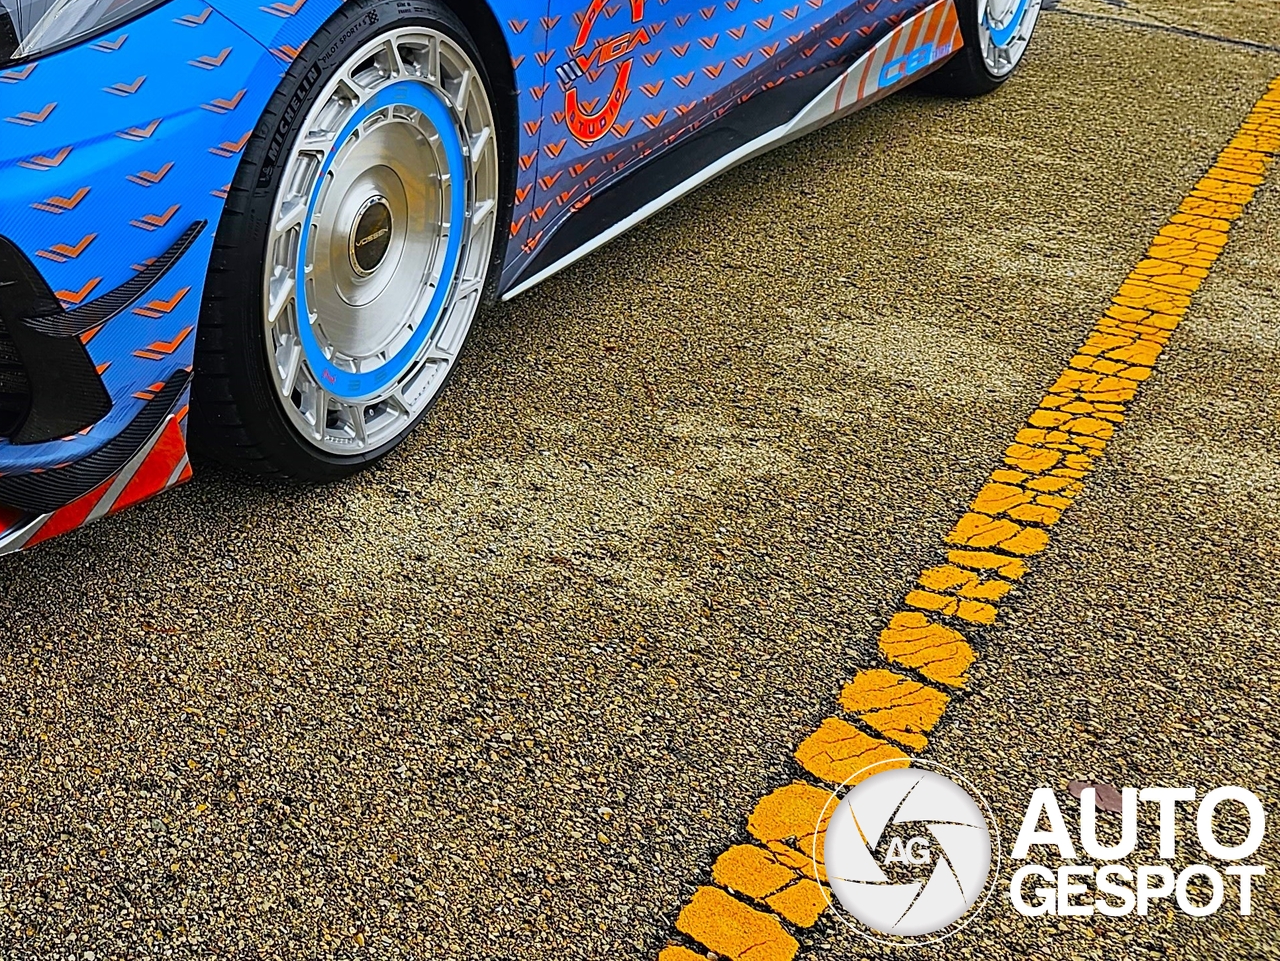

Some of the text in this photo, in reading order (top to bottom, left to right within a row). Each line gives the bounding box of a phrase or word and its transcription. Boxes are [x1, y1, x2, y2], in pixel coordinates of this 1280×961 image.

[322, 44, 339, 63] PILOT
[339, 25, 360, 46] SPORT
[878, 42, 934, 88] C8
[267, 67, 320, 164] MICHELIN
[570, 87, 622, 135] STUDIO
